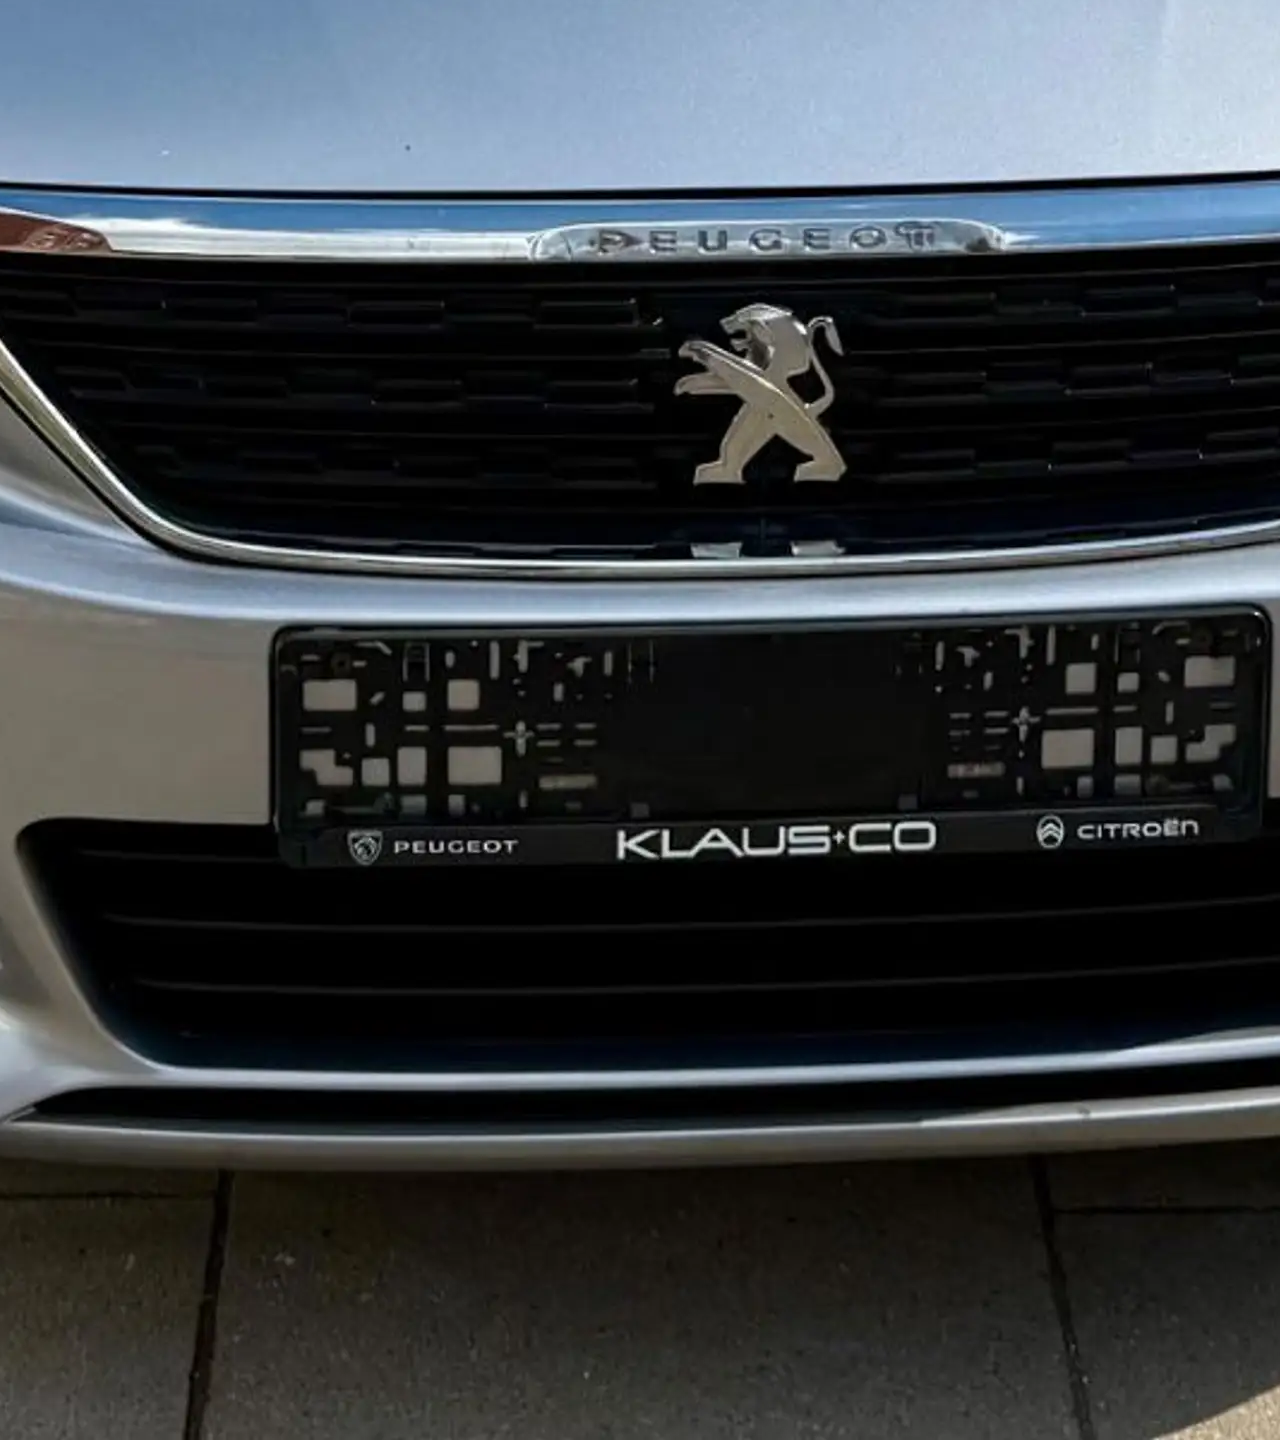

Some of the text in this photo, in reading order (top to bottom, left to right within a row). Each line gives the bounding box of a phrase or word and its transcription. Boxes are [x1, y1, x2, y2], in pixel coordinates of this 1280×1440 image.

[596, 220, 938, 254] PEUGEOT
[1076, 818, 1200, 840] CITROËN
[393, 839, 519, 855] PEUGEOT
